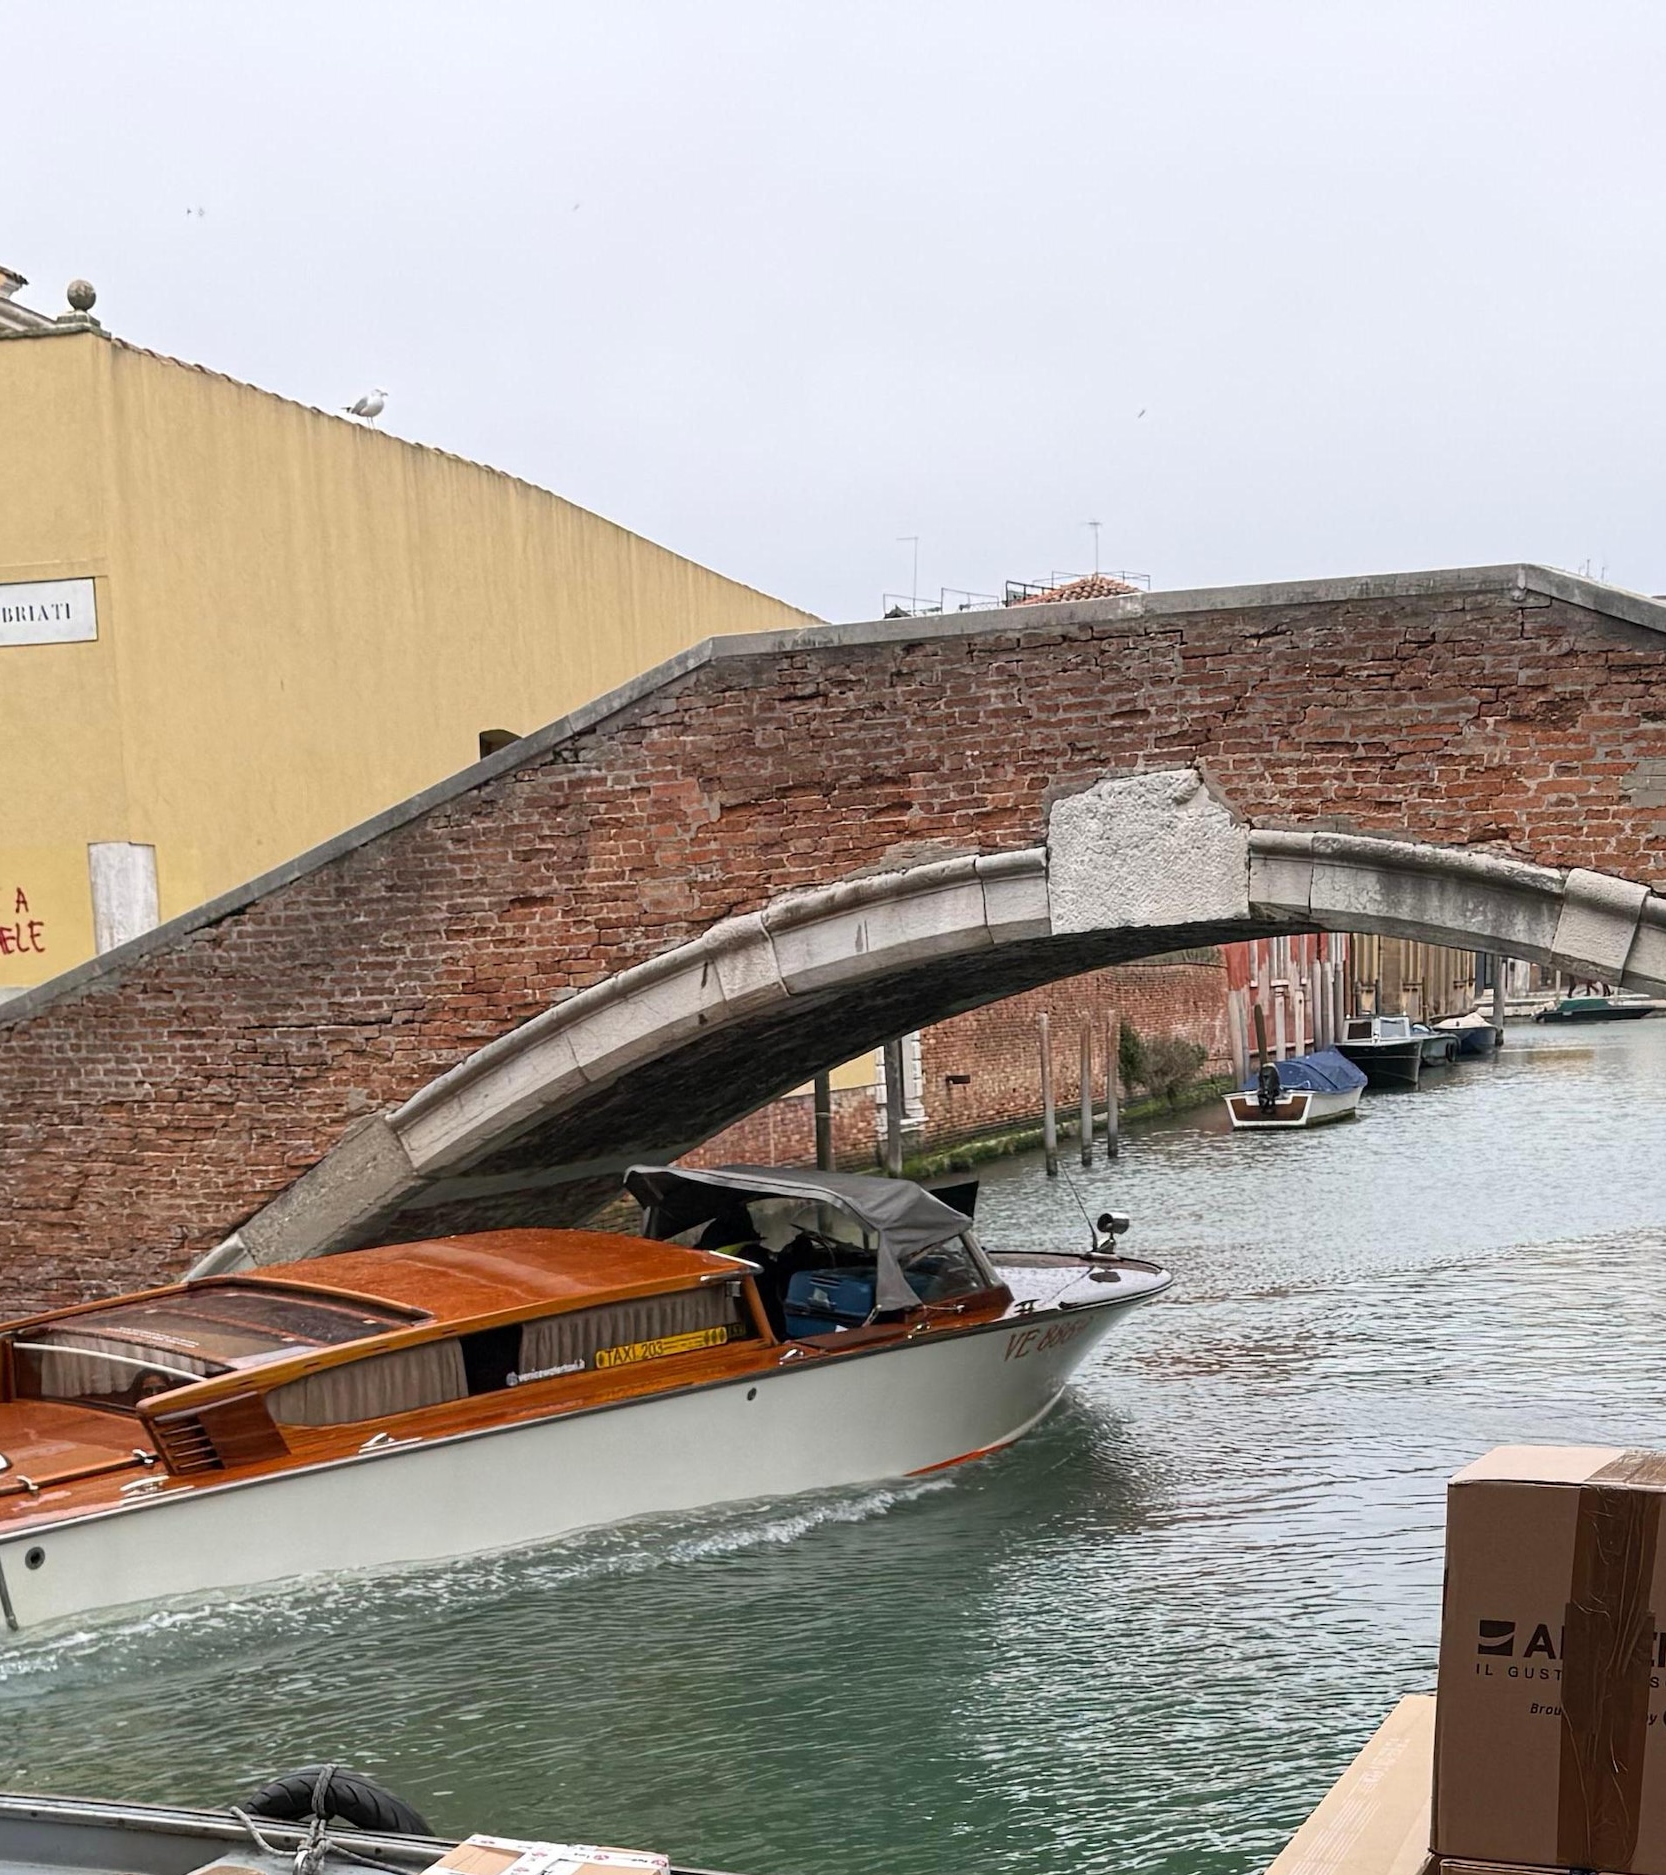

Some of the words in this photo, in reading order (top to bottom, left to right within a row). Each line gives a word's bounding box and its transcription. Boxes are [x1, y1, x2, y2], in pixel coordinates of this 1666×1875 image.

[2, 603, 72, 624] BRIATI
[16, 887, 29, 913] A
[1004, 1328, 1041, 1362] VE
[605, 1347, 637, 1367] TAXI
[1476, 1663, 1494, 1676] IL
[1508, 1665, 1562, 1681] GUST
[1530, 1702, 1562, 1716] Brou
